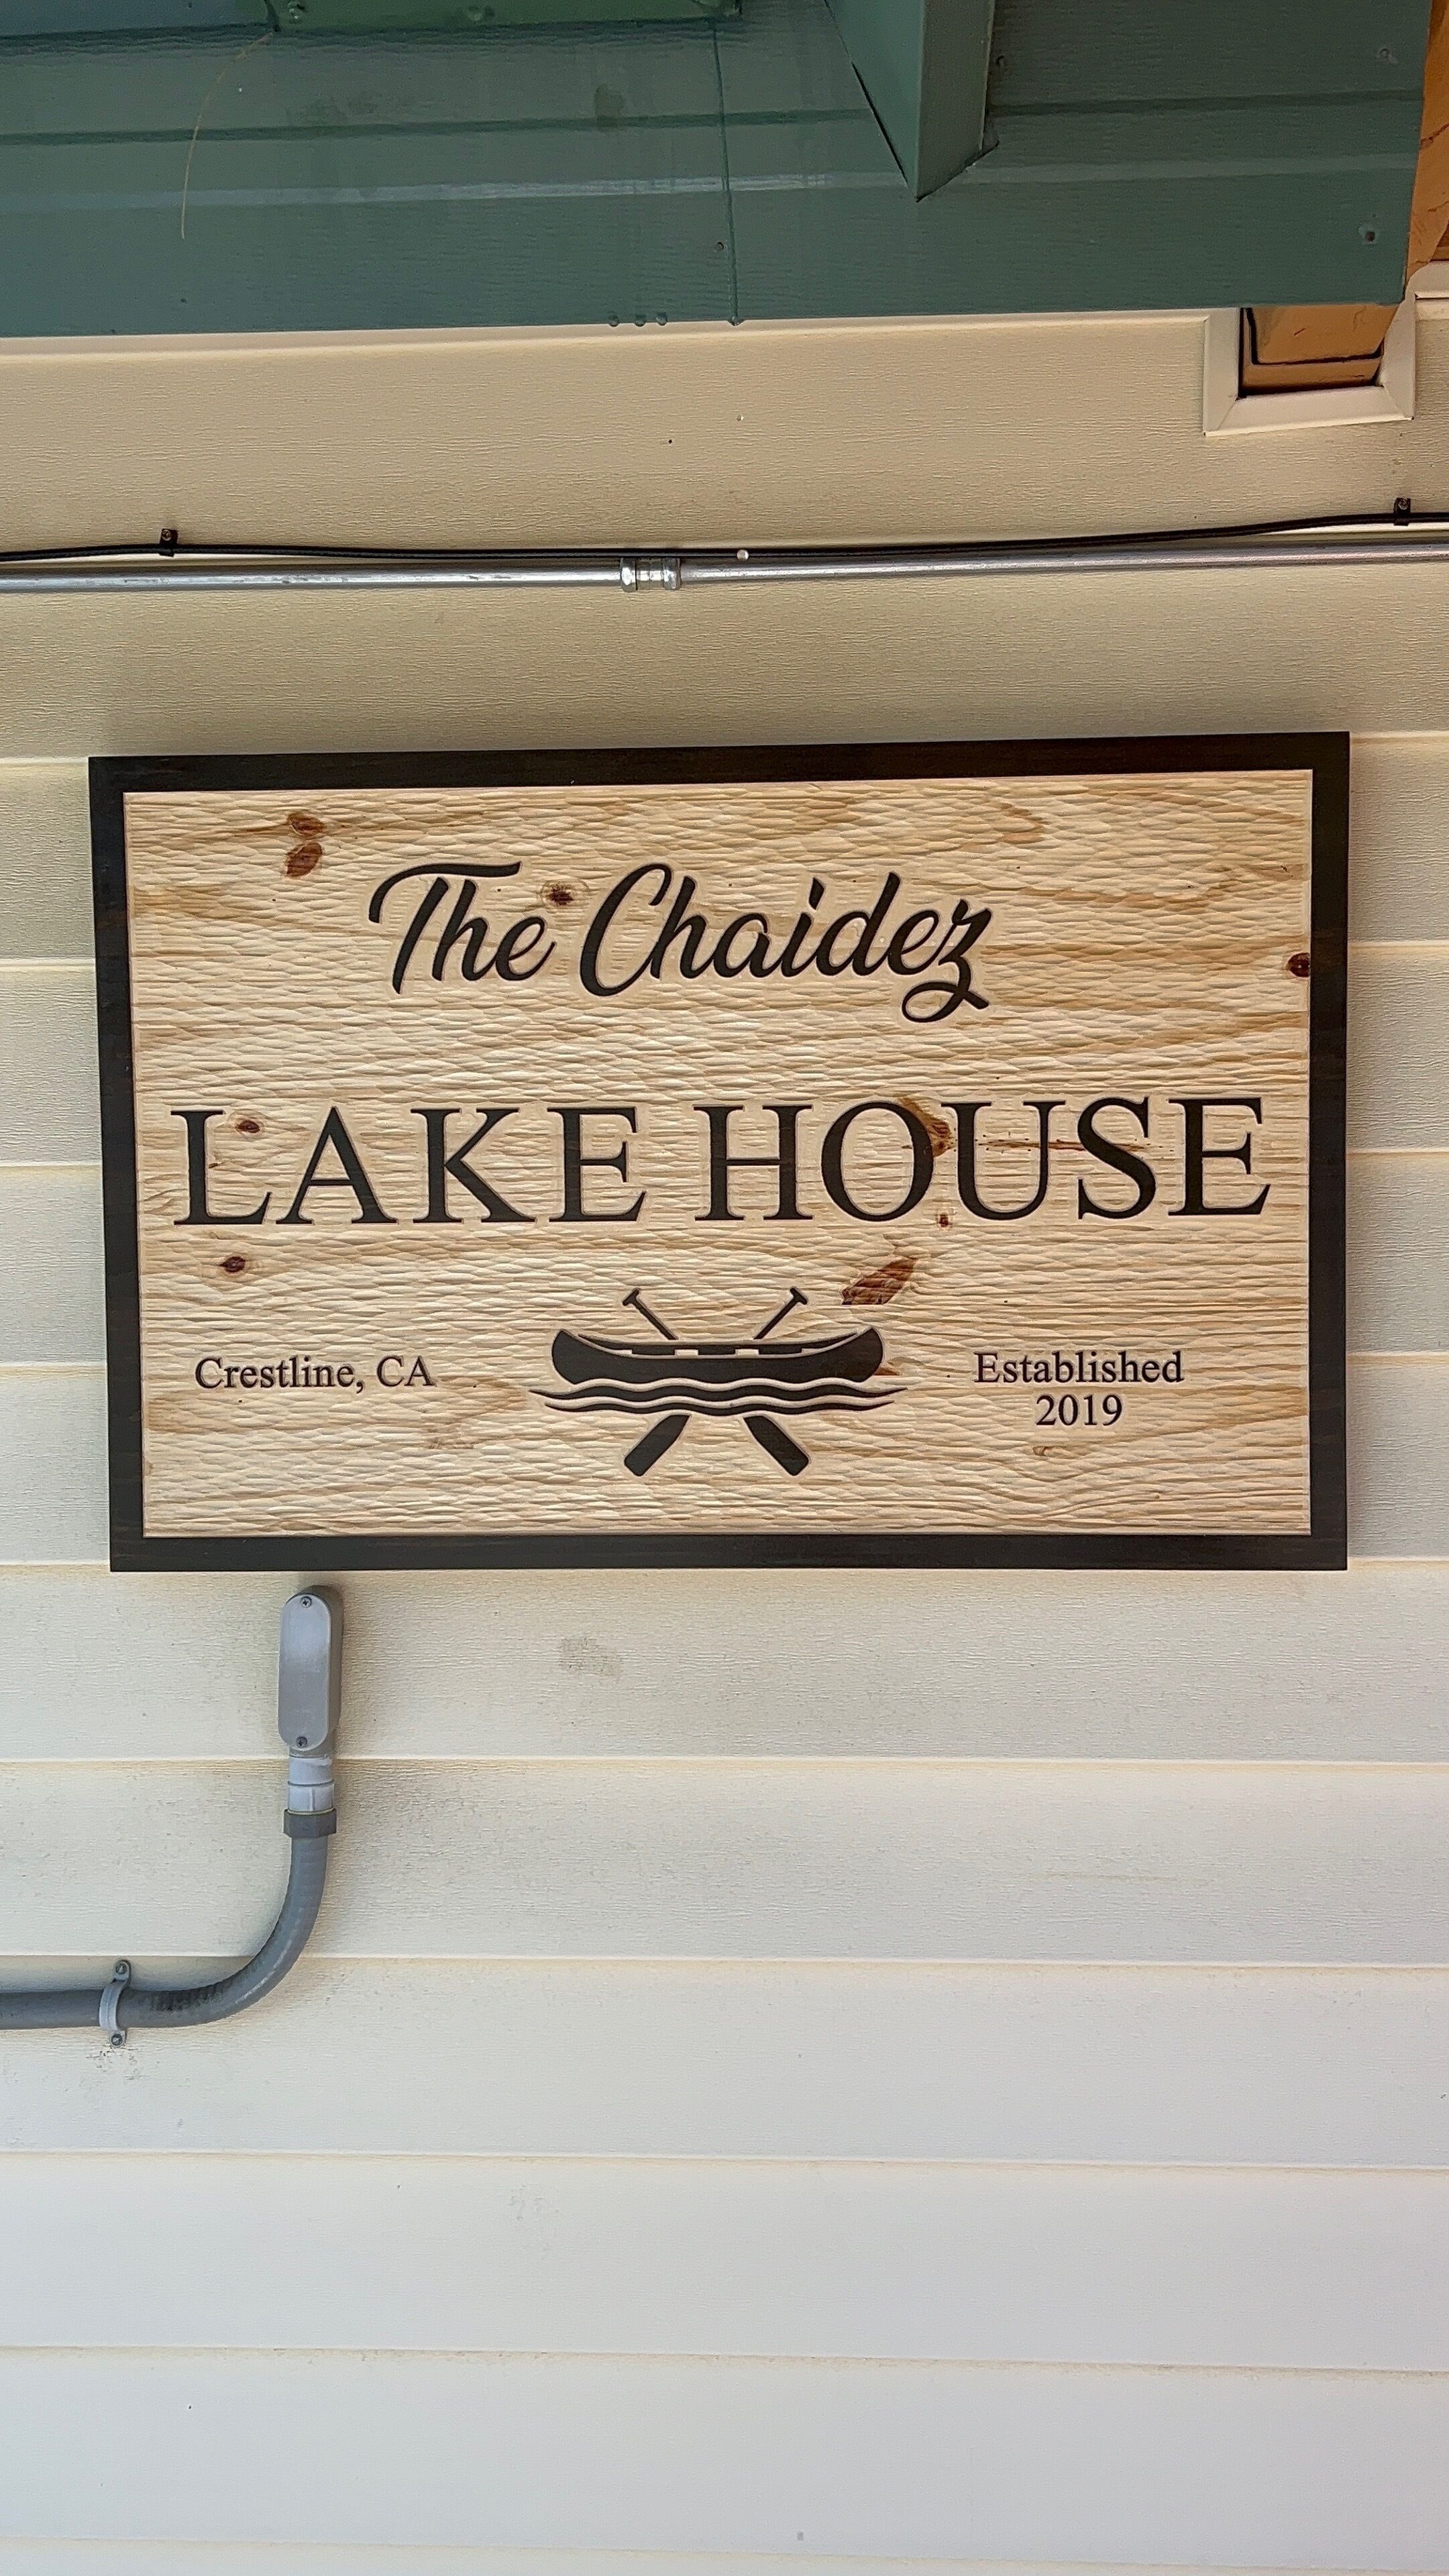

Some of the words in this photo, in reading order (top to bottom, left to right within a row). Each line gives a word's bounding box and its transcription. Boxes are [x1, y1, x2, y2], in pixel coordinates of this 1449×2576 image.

[369, 861, 555, 994] The
[580, 863, 993, 1023] Chaidez
[171, 1106, 646, 1226] LAKE
[694, 1095, 1271, 1222] HOUSE
[195, 1356, 364, 1394] Crestline,
[376, 1354, 436, 1387] CA
[973, 1350, 1184, 1384] Established
[1036, 1394, 1122, 1426] 2019
